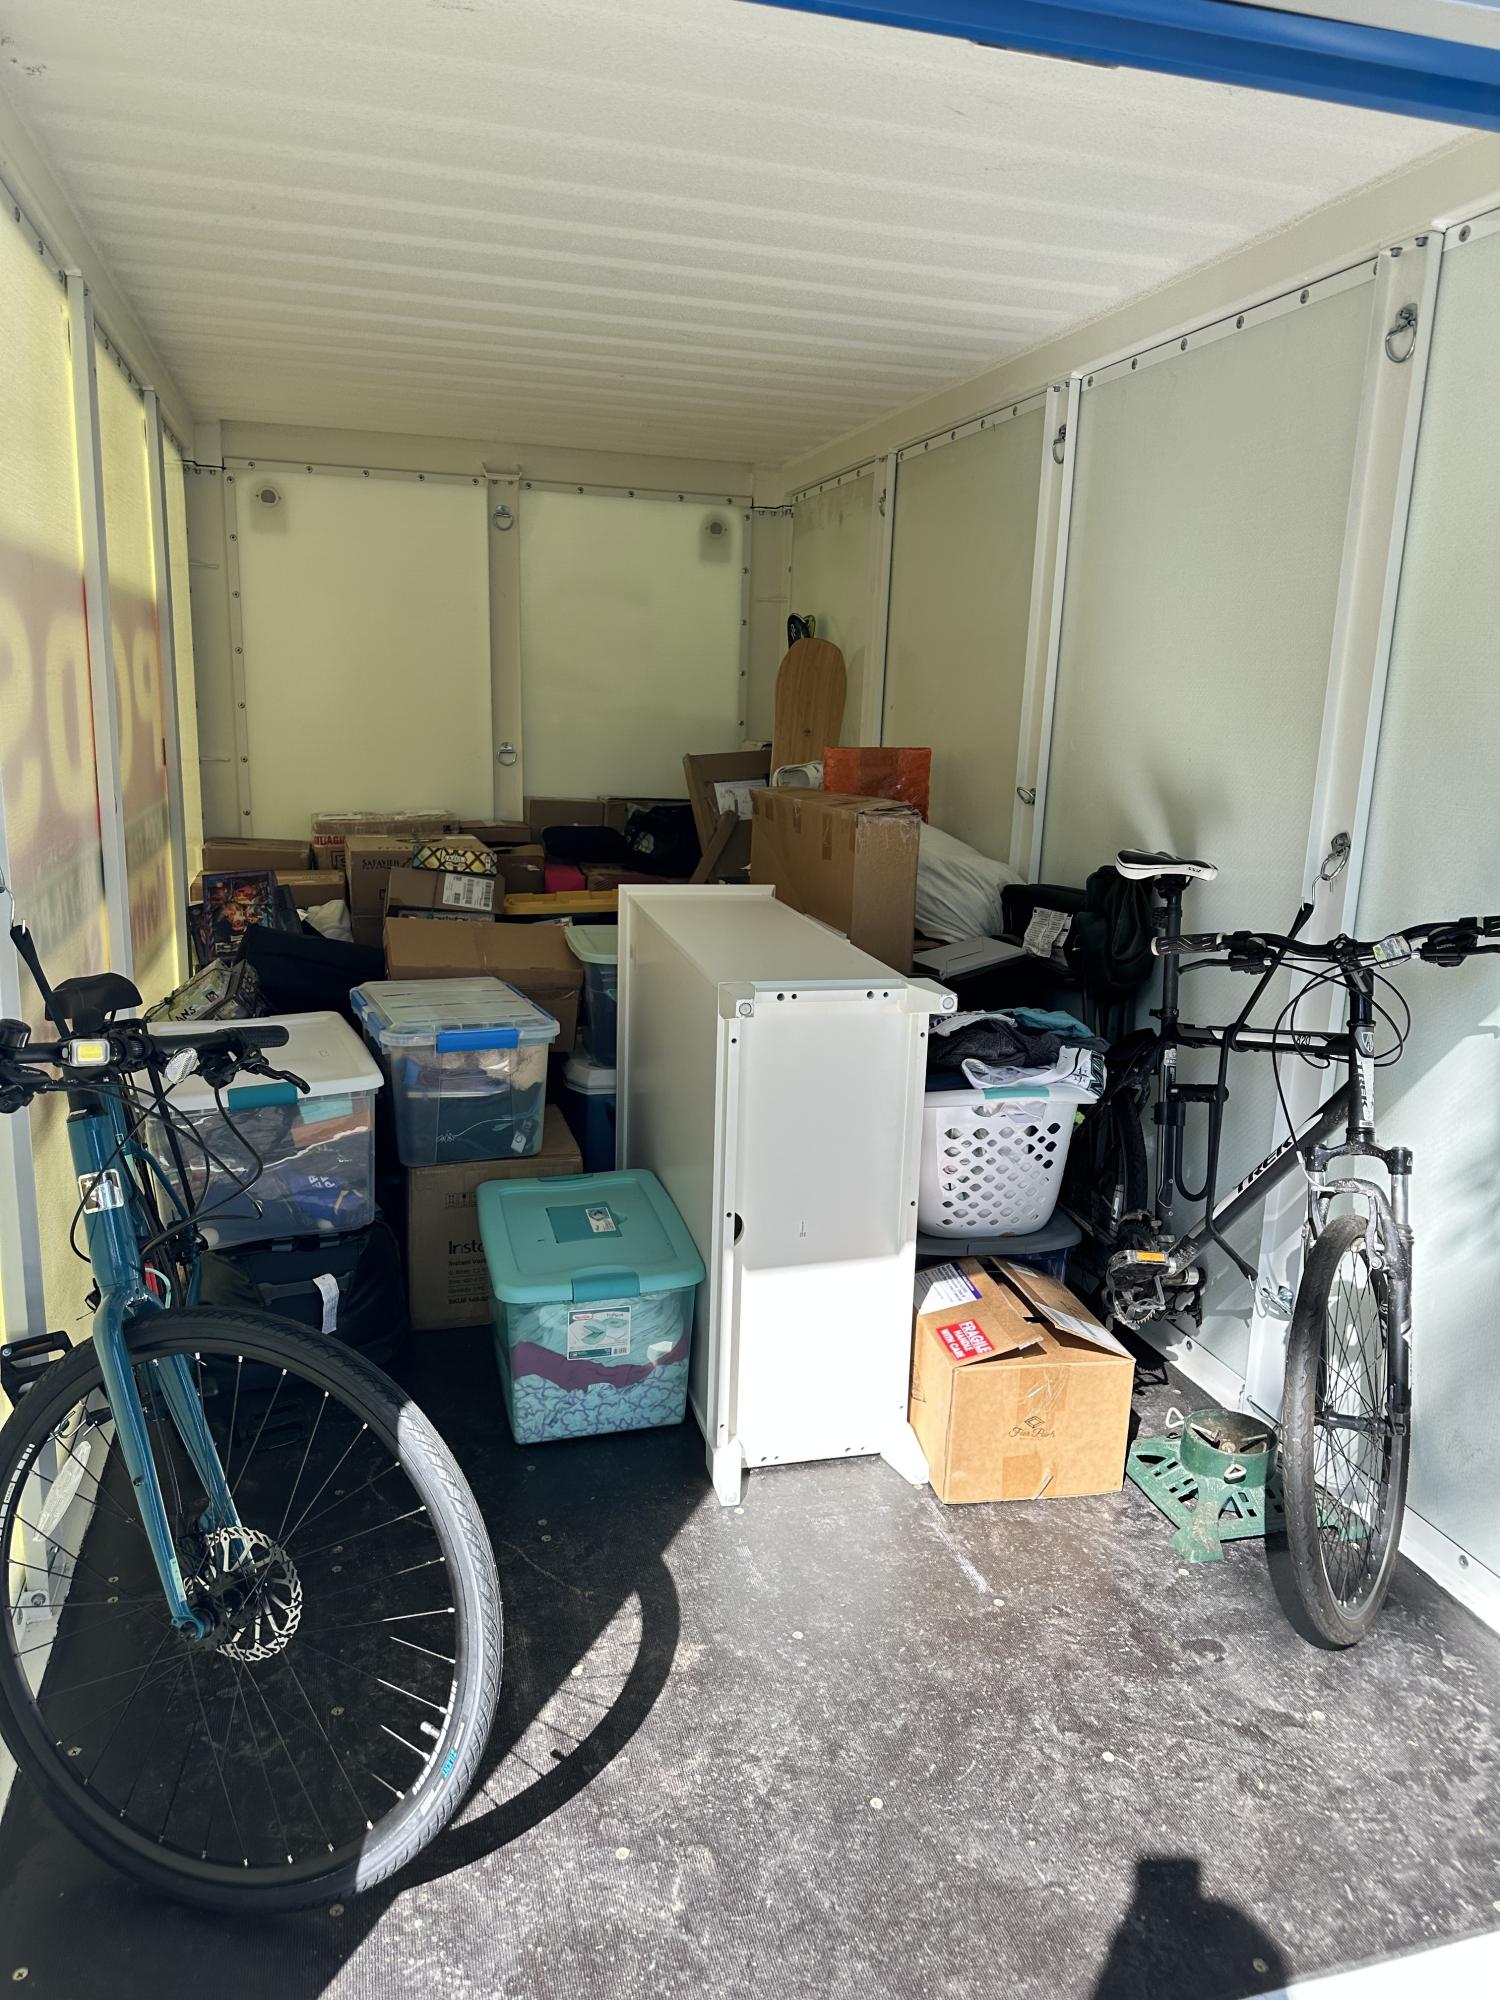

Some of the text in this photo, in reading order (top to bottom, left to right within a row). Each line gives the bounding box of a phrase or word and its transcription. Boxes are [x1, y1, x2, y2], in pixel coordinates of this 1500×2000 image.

[1233, 1134, 1294, 1194] TREK
[953, 1329, 974, 1352] HANDLE
[961, 1320, 993, 1354] FRAGILE
